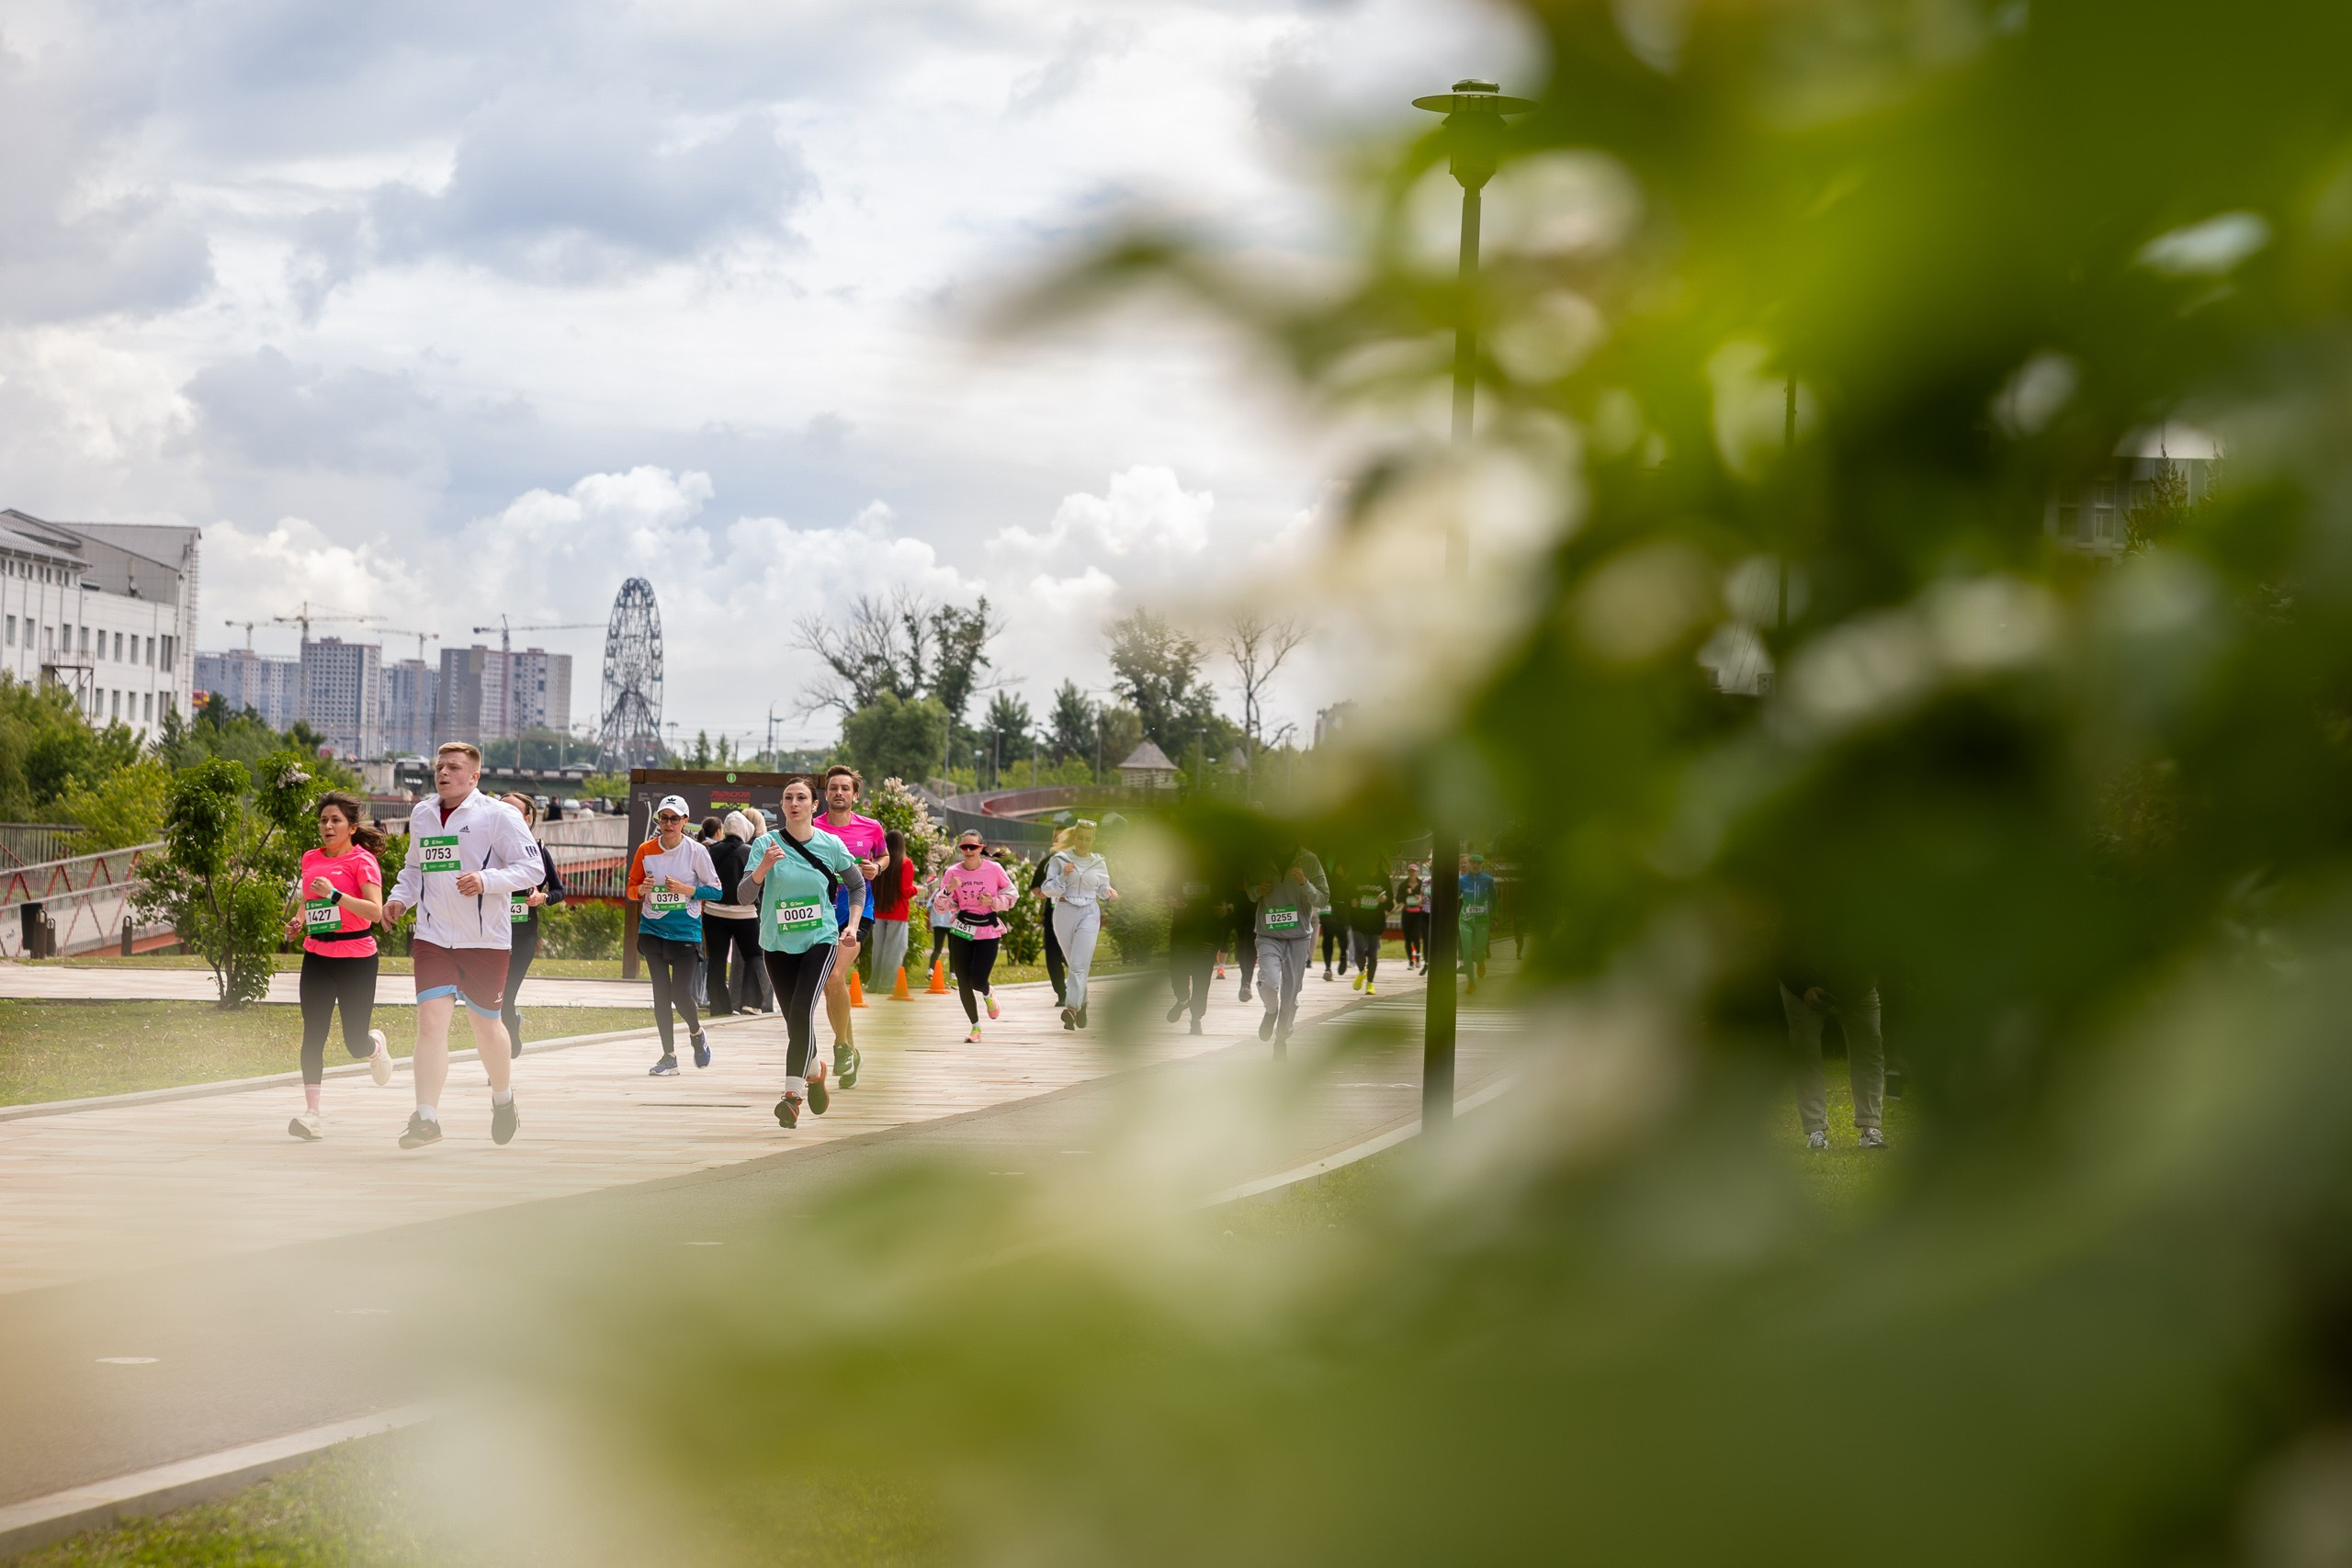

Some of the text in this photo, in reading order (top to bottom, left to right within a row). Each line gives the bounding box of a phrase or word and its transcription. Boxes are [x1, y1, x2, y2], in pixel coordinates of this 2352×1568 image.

[425, 848, 451, 860] 0753
[656, 893, 679, 902] 0378
[511, 905, 522, 913] 43
[784, 908, 813, 920] 0002
[308, 908, 331, 922] 1427
[1271, 913, 1292, 922] 0255
